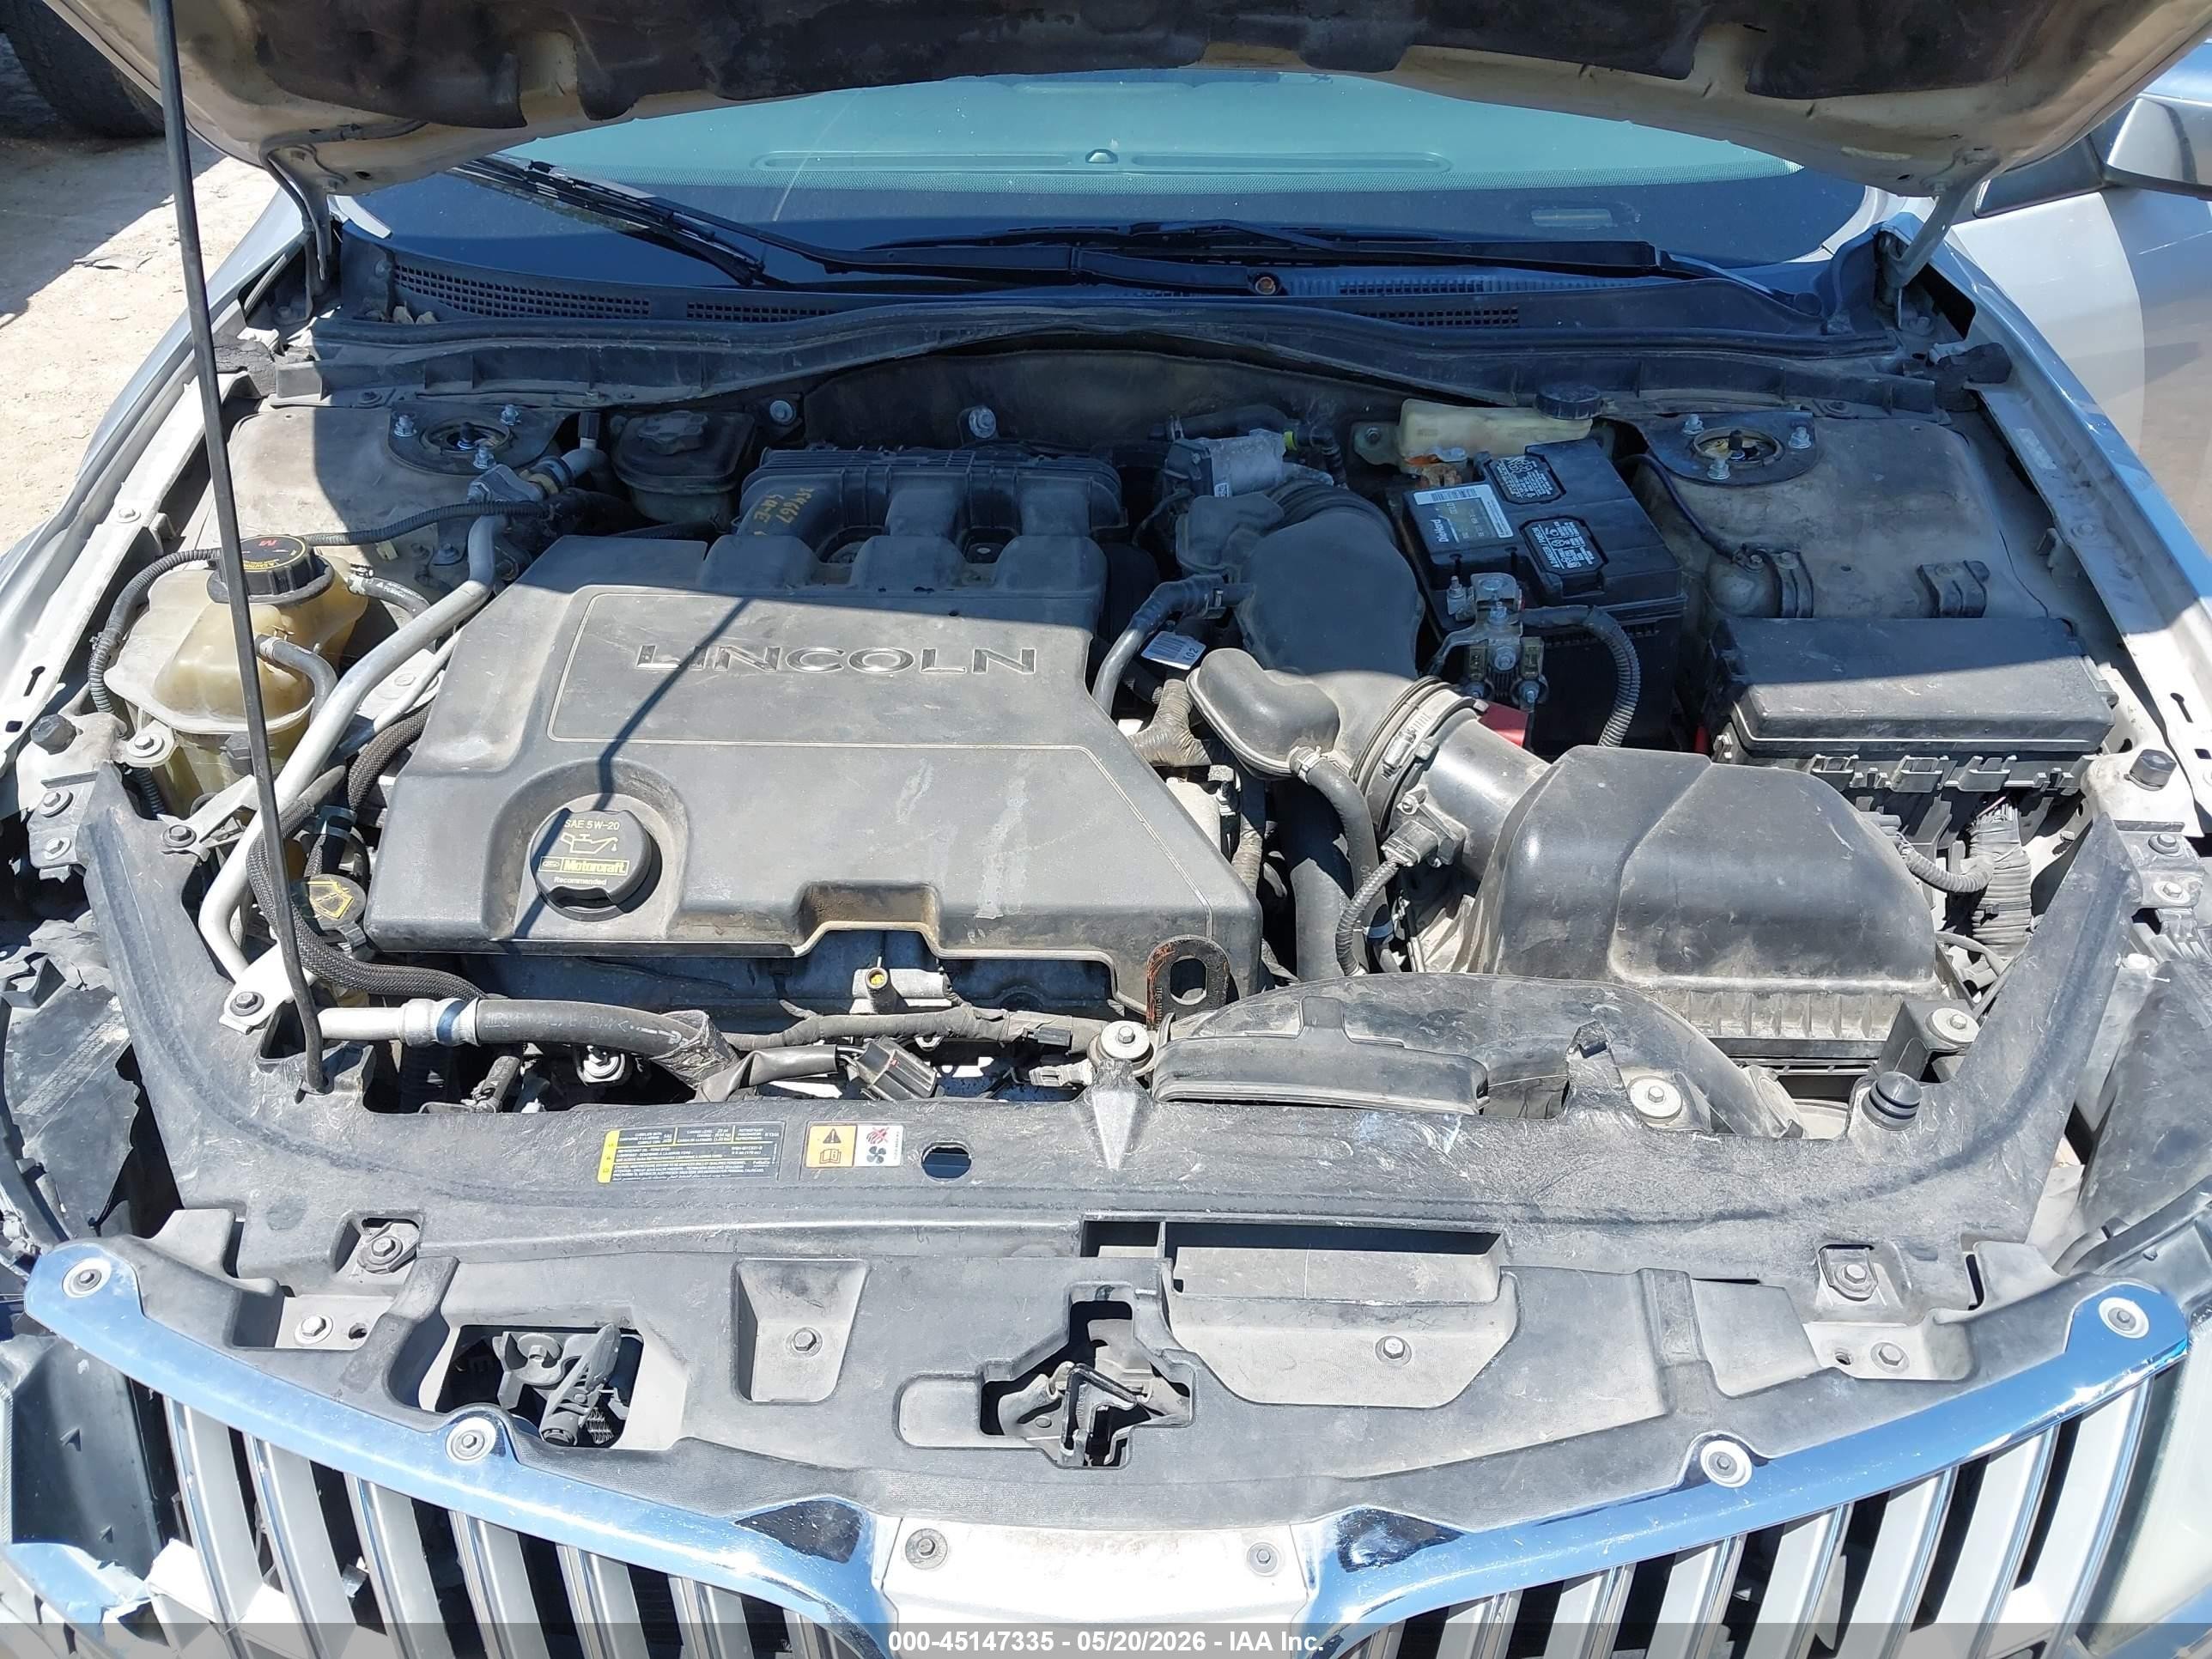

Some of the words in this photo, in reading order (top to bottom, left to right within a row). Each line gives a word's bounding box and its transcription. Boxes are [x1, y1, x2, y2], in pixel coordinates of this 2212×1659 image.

[1430, 519, 1449, 543] DieHard
[635, 645, 1037, 674] LINCOLN
[564, 819, 584, 829] SAE
[586, 820, 620, 830] 5W-20
[563, 859, 625, 873] Motorcraft
[554, 877, 607, 885] Recommended
